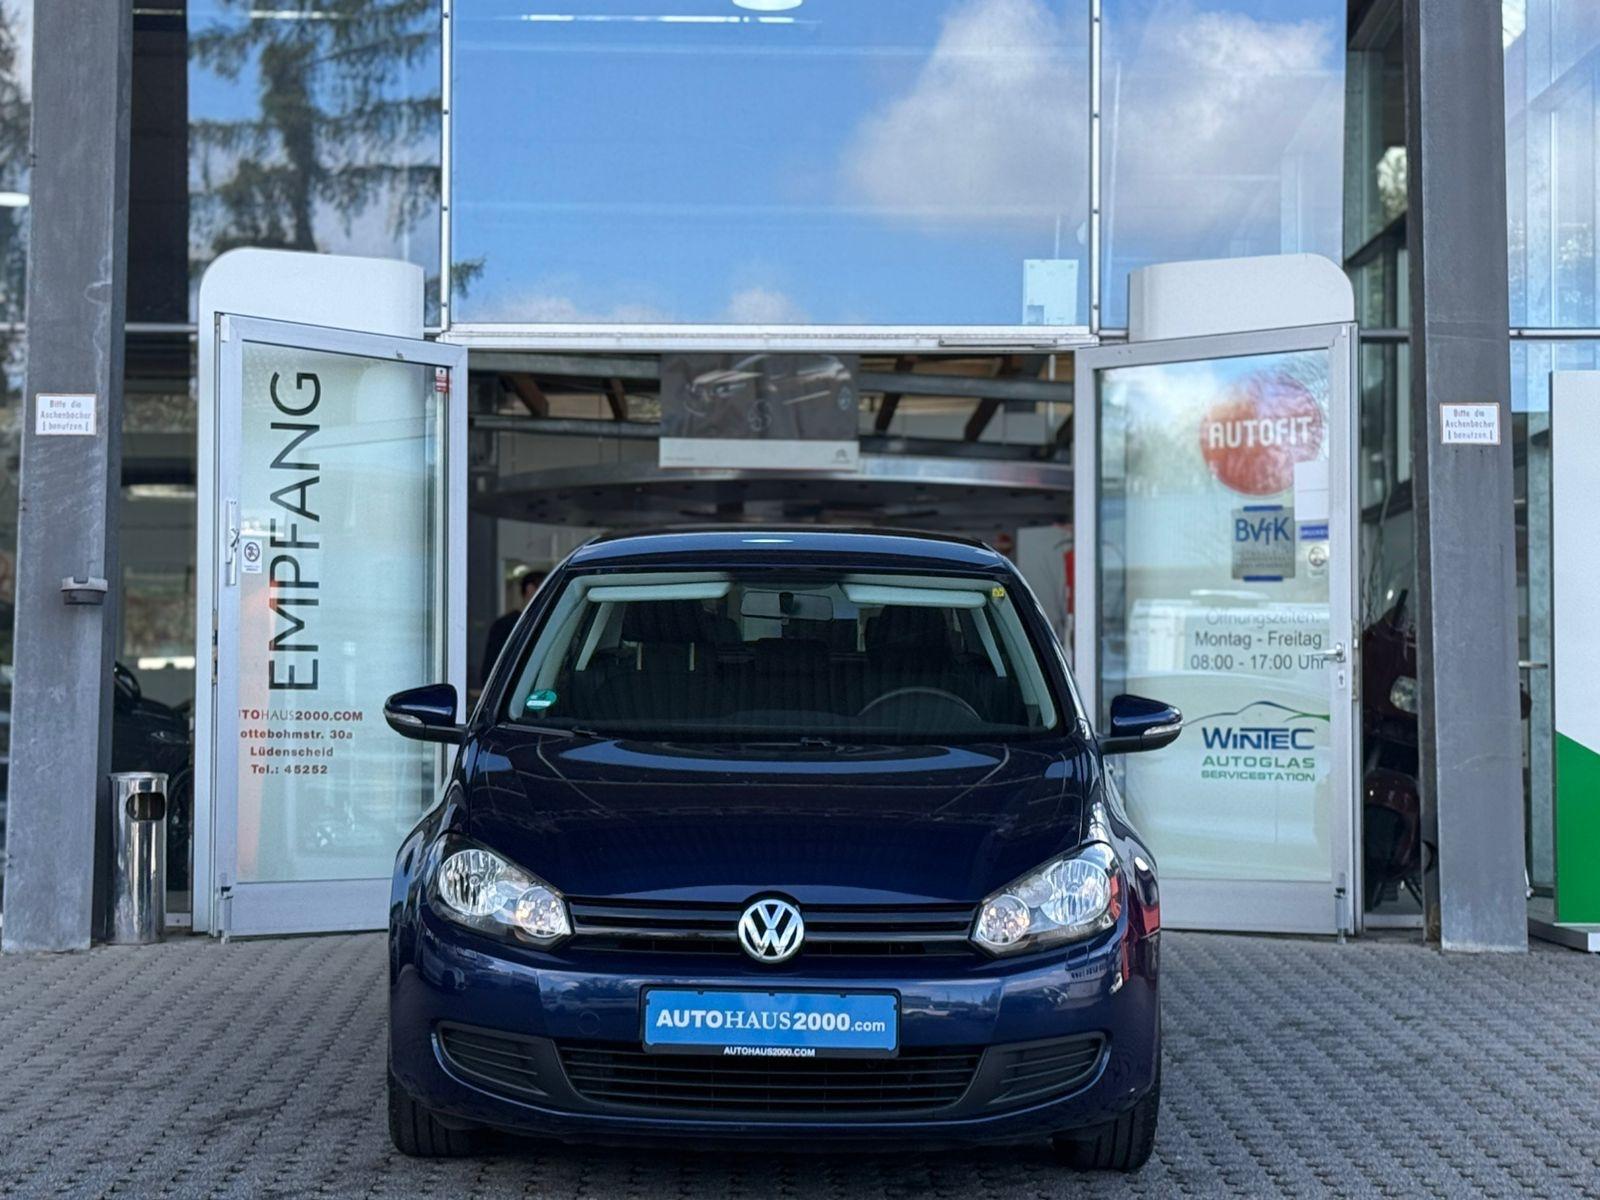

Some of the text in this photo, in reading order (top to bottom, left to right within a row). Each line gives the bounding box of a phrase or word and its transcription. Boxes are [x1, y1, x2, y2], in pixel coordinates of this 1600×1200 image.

[1208, 416, 1313, 450] AUTOFIT
[268, 371, 321, 690] EMPFANG
[1235, 516, 1291, 546] BVfK
[1194, 630, 1252, 650] Montag
[1267, 630, 1322, 650] Freitag
[1190, 653, 1234, 670] 08:00
[1250, 653, 1293, 670] 17:00
[1298, 653, 1326, 670] Uhr
[238, 709, 363, 721] TOHAUS2000.COM
[240, 729, 353, 740] ottebohmstr. 30a
[250, 746, 334, 757] Lüdenscheid
[1202, 756, 1316, 769] AUTOGLAS
[251, 764, 328, 775] Tel.: 45252
[1201, 770, 1316, 782] SERVICESTATION
[655, 1009, 886, 1032] AUTOHAUS2000.com
[723, 1046, 816, 1058] AUTOHAUS2000.COM
